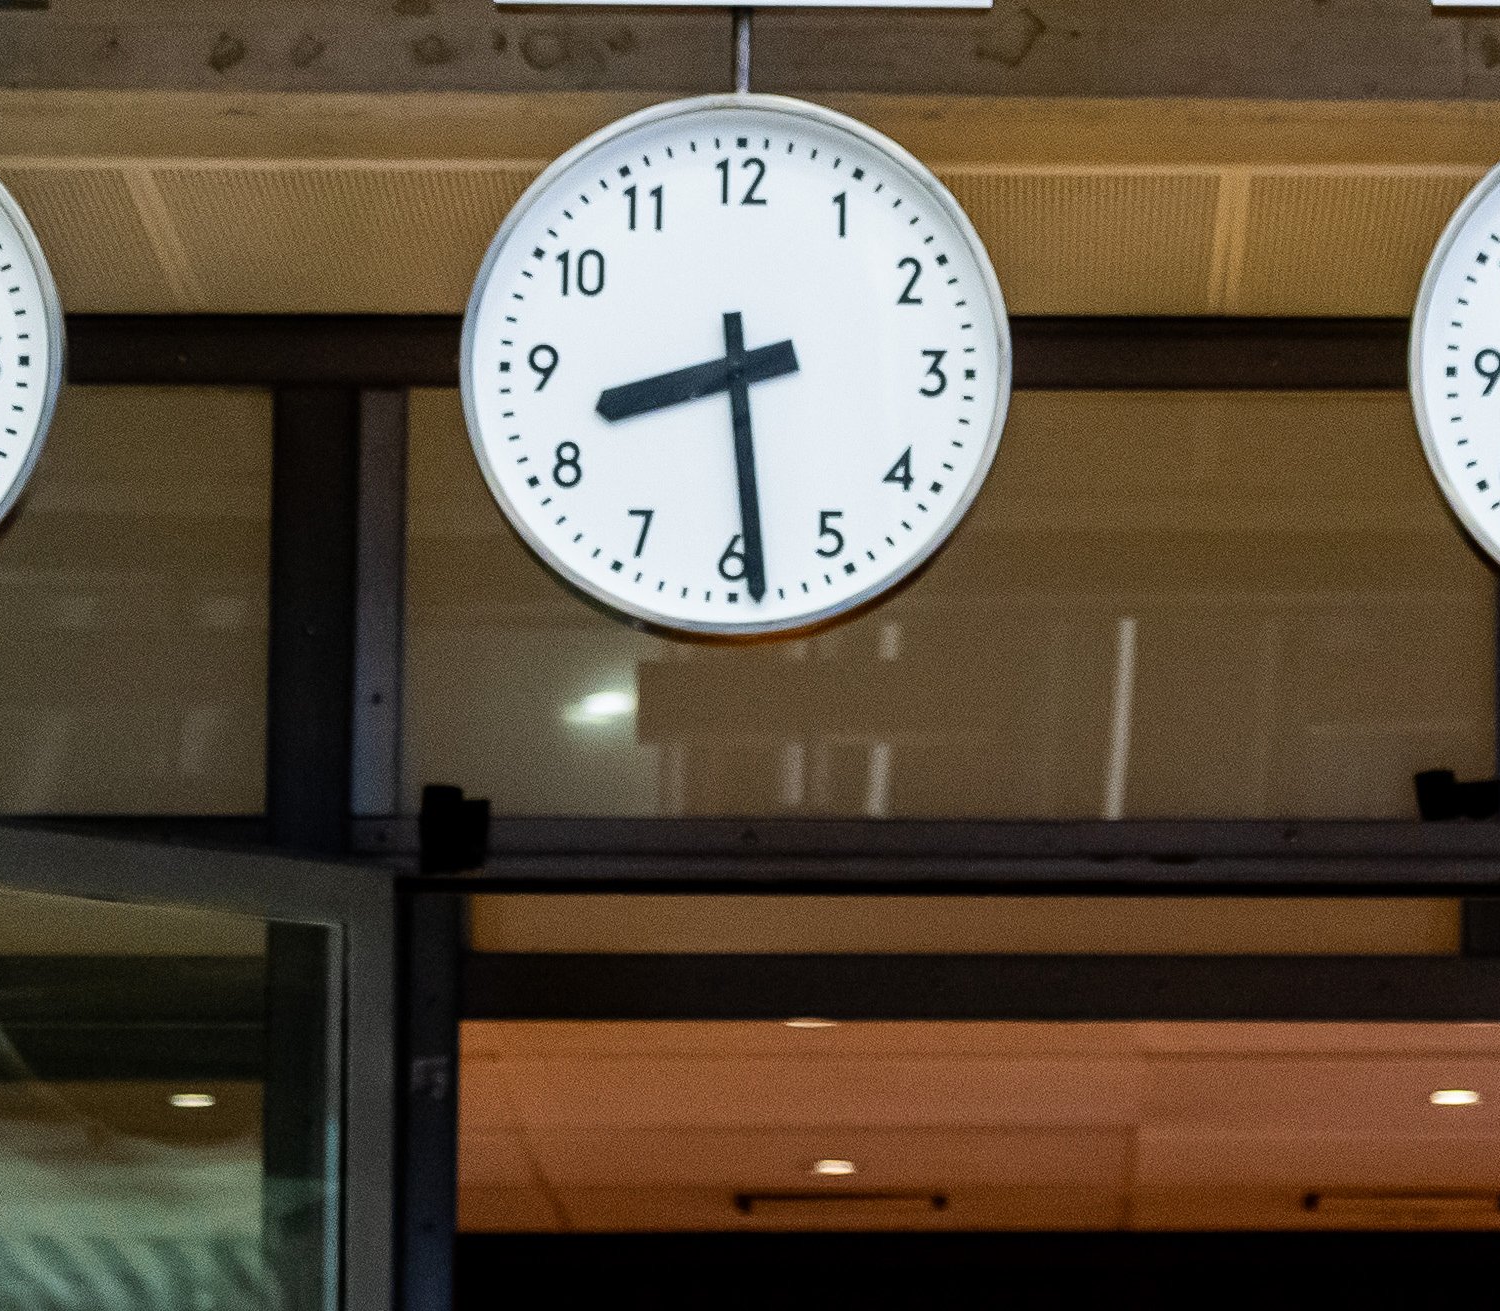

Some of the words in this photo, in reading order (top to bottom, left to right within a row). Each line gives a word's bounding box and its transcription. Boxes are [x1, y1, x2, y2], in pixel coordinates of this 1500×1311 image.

[716, 157, 767, 205] 12
[623, 185, 663, 231] 11
[832, 191, 846, 238] 1
[556, 248, 605, 297] 10
[897, 256, 923, 305] 2
[527, 343, 559, 392] 9
[919, 349, 947, 398] 3
[552, 440, 583, 489] 8
[883, 446, 914, 491] 4
[628, 509, 654, 557] 7
[718, 534, 750, 580] 6
[816, 510, 845, 558] 5
